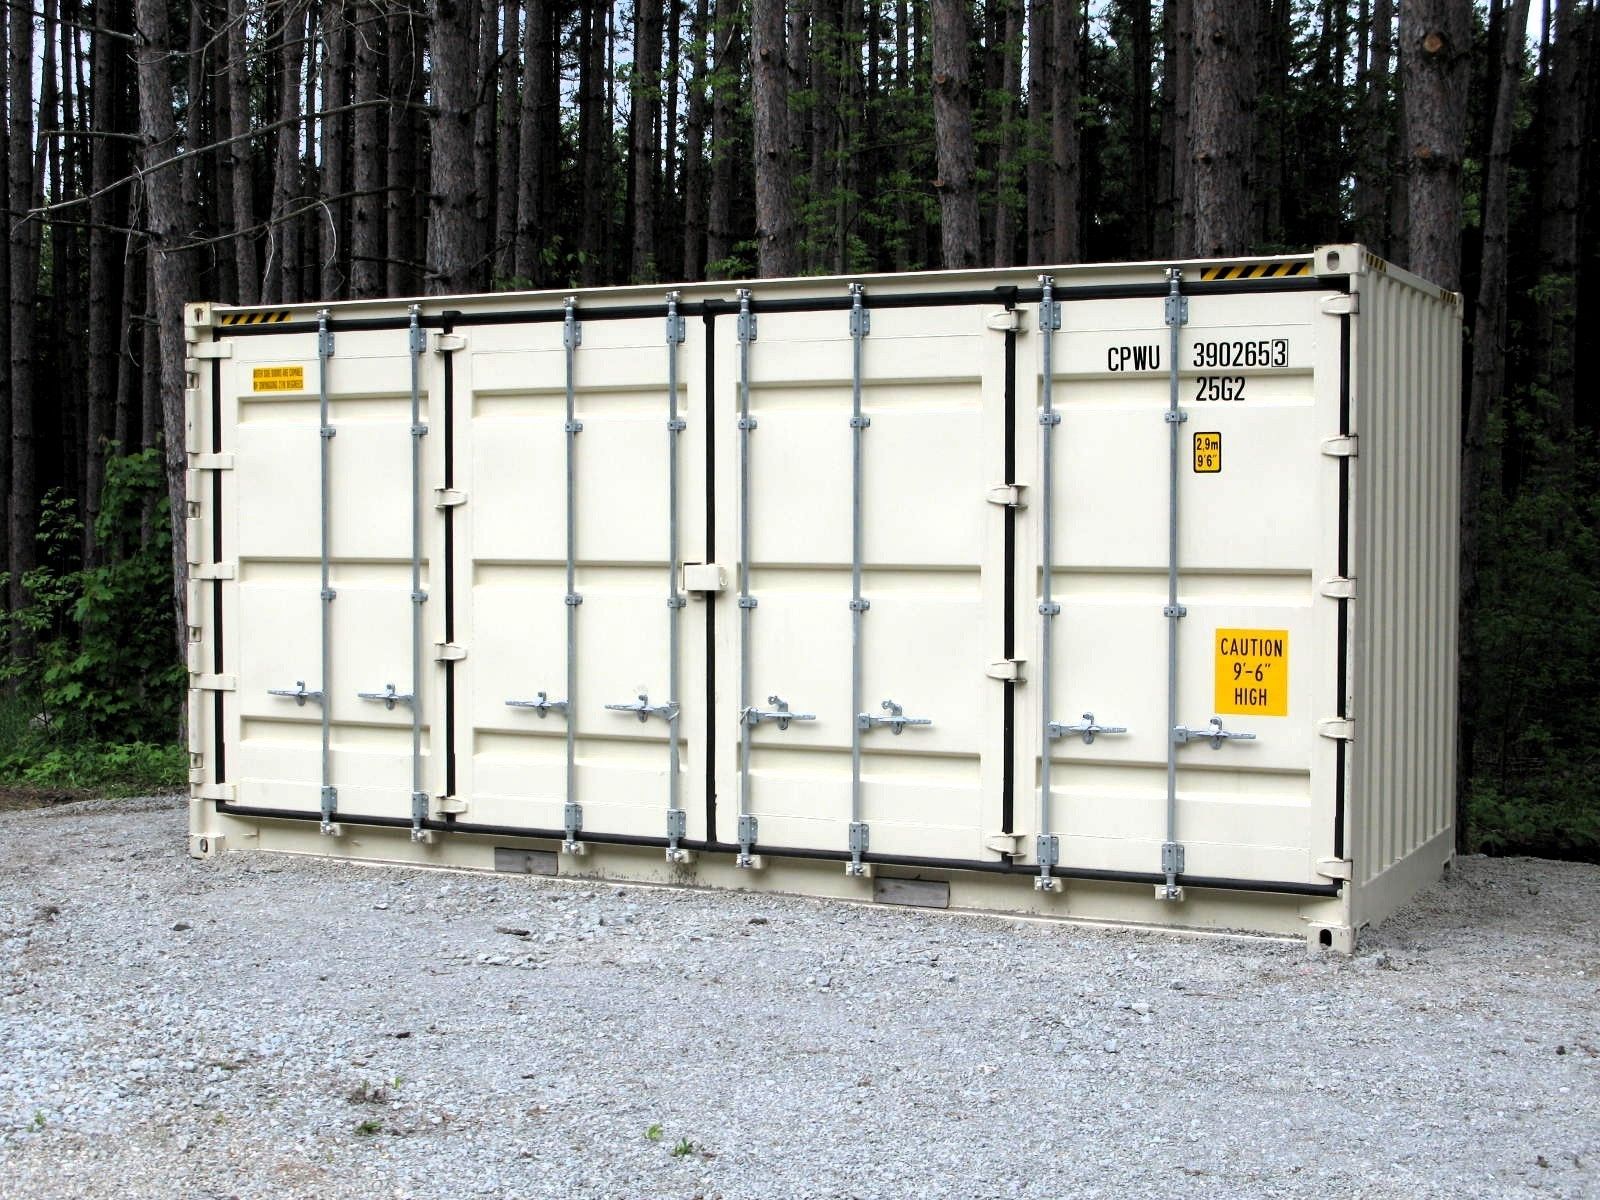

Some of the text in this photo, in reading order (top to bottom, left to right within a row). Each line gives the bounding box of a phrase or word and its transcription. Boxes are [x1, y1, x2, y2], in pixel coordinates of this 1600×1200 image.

[1108, 345, 1160, 371] CPWU
[1195, 376, 1246, 401] 25G2
[1221, 637, 1283, 657] CAUTION
[1234, 662, 1271, 682] 9'-6"
[1234, 688, 1267, 706] HIGH
